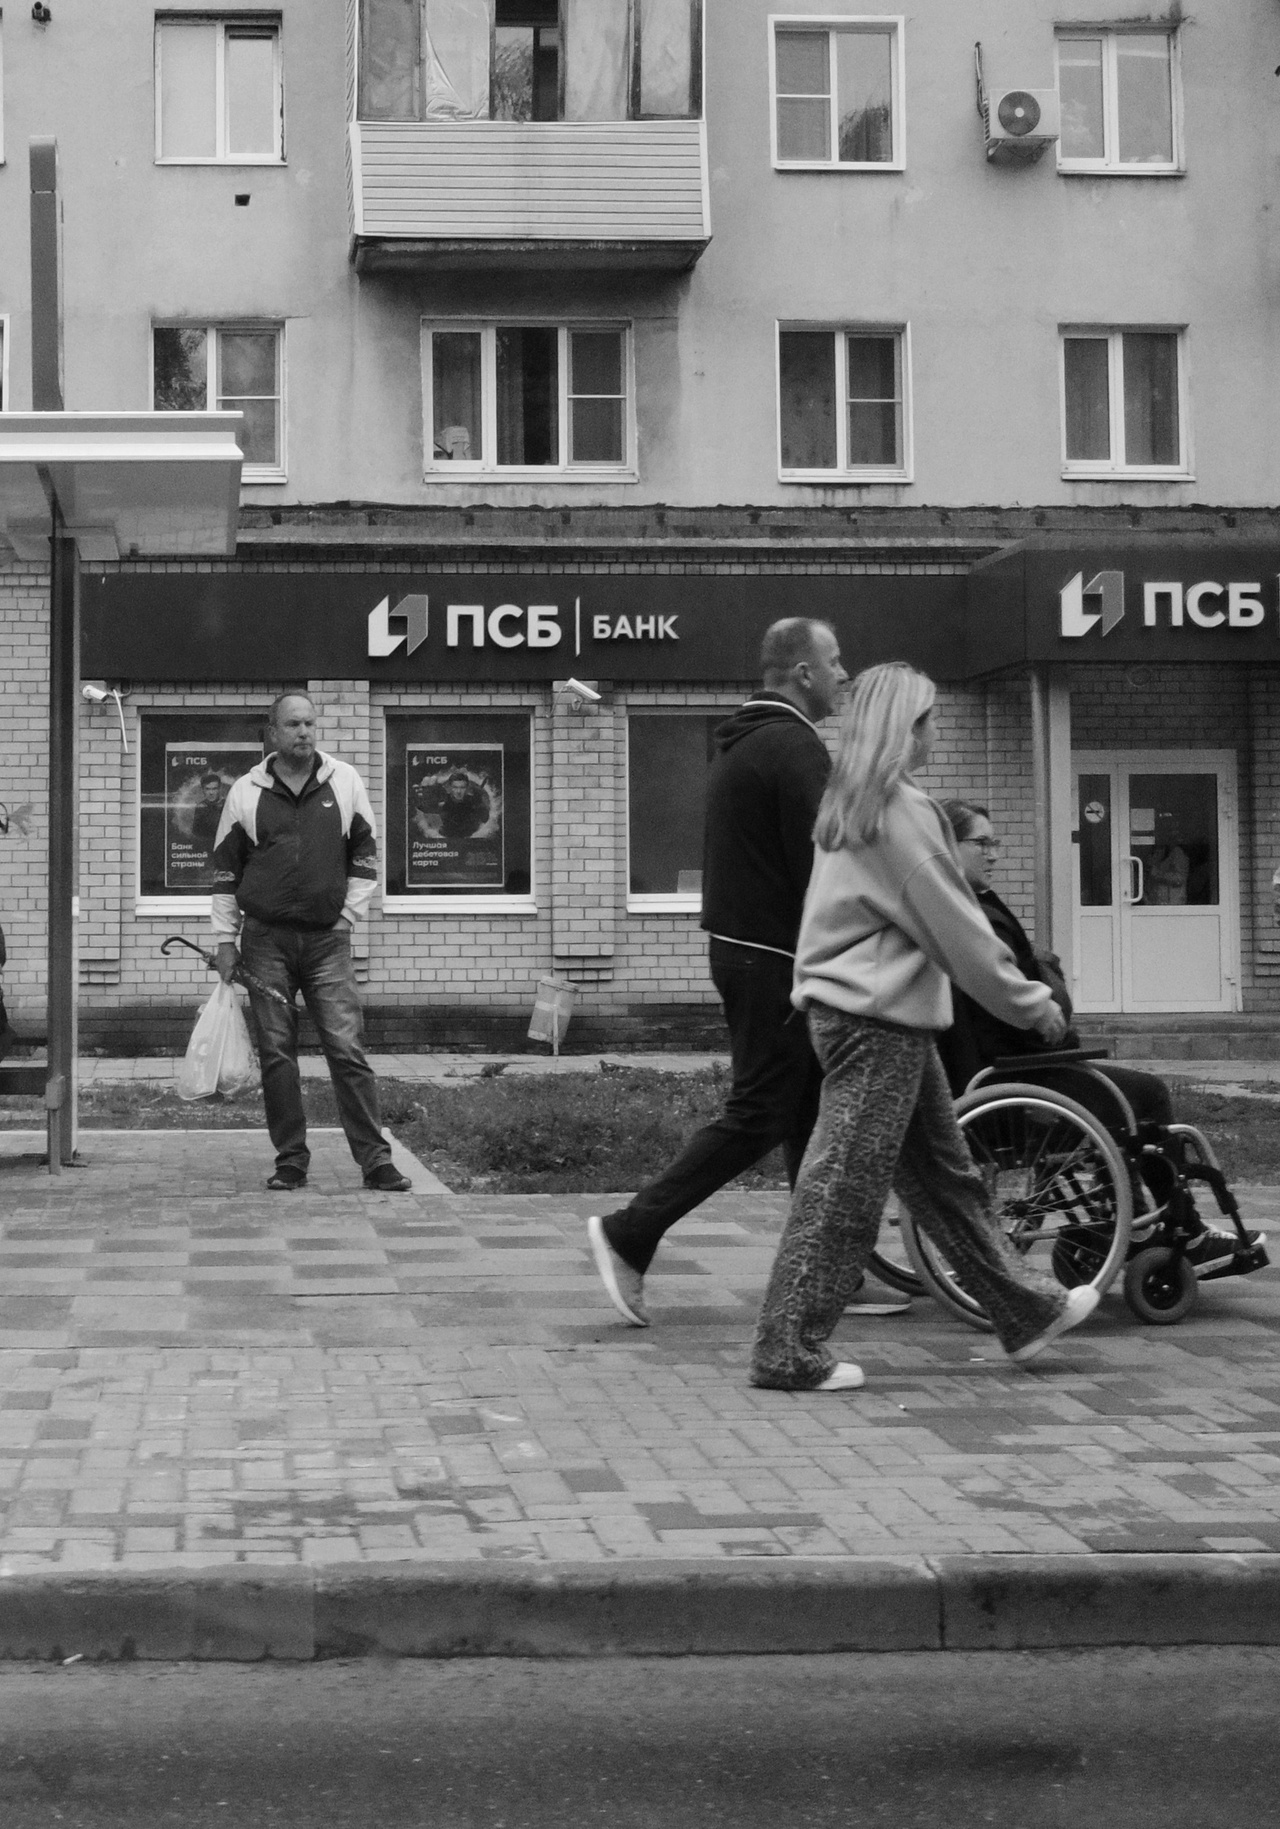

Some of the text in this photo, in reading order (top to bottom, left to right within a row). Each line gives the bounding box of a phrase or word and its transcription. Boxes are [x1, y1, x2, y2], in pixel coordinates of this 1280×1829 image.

[1143, 580, 1265, 628] ПСБ
[446, 603, 680, 648] ПСБ БАНК
[185, 757, 207, 765] ПСБ
[426, 756, 448, 765] ПСБ
[171, 842, 193, 850] Банк
[412, 841, 448, 850] Лучшая
[171, 851, 208, 859] сильной
[412, 850, 459, 858] дебетовая
[171, 860, 205, 868] страны
[412, 859, 439, 867] карта
